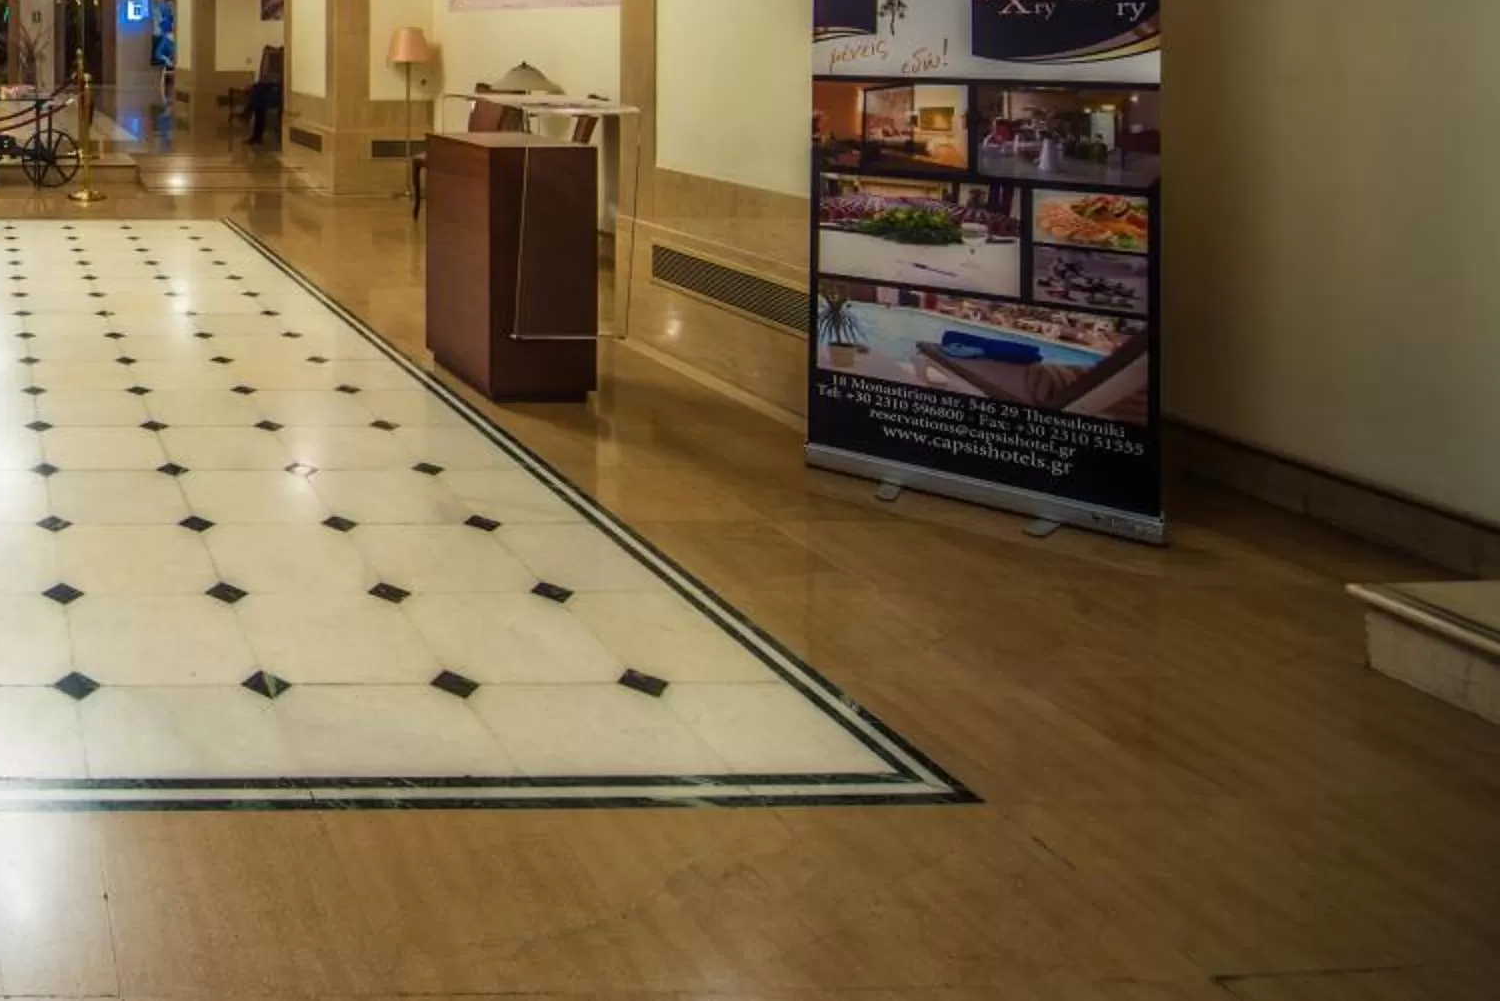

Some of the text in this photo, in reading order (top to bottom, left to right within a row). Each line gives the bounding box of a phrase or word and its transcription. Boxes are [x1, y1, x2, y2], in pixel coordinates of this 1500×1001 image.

[847, 392, 871, 404] +30
[875, 395, 909, 410] 2310
[1000, 405, 1019, 417] 29
[1024, 408, 1125, 438] Thessaloniki
[883, 426, 1073, 476] www.capsishotels.gr
